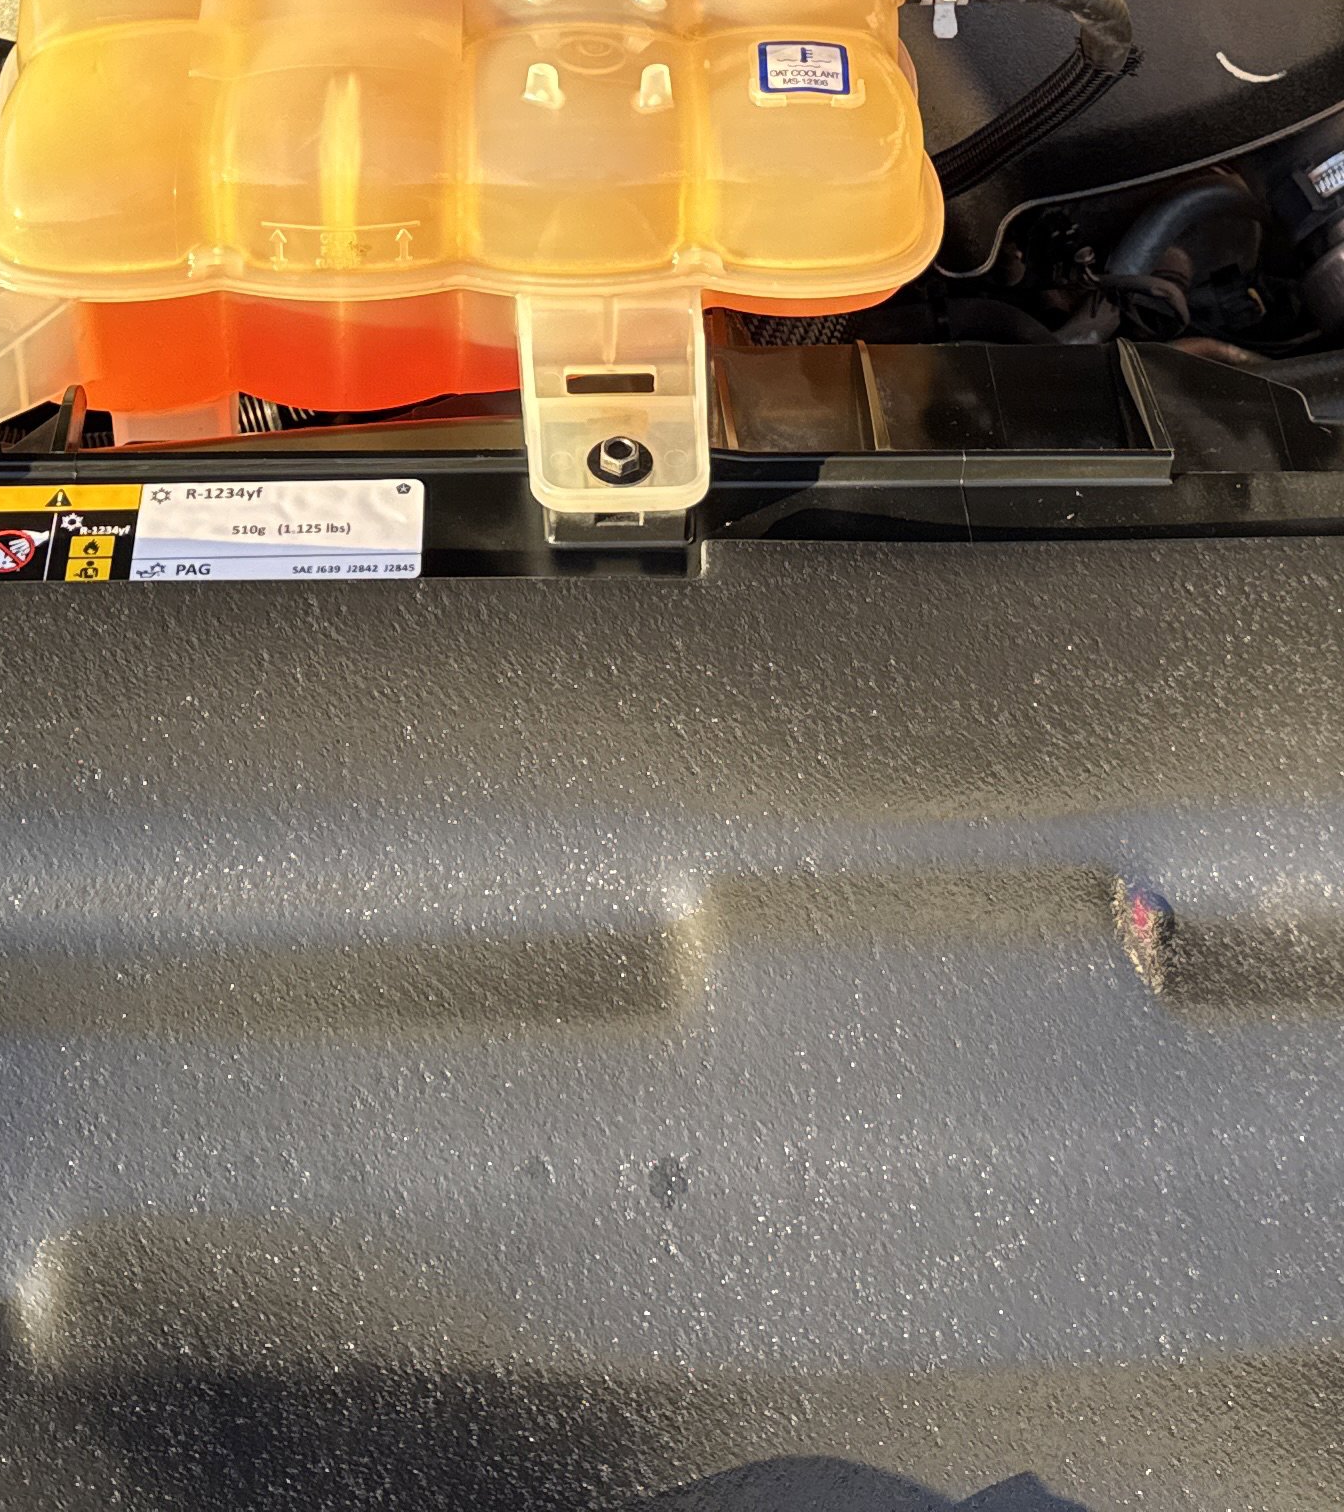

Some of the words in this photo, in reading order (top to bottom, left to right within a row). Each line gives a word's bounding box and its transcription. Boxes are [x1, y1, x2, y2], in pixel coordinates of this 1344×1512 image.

[770, 69, 788, 77] OAT
[790, 69, 840, 79] COOLANT
[185, 487, 264, 501] R-1234yf
[79, 524, 131, 536] R-1234yf
[231, 523, 267, 536] 510g
[277, 523, 322, 535] (1.125
[325, 522, 352, 534] lbs)
[175, 562, 212, 576] PAG
[292, 564, 313, 574] SAE
[316, 563, 341, 574] J639
[346, 563, 379, 573] J2842
[383, 562, 416, 572] J2845
